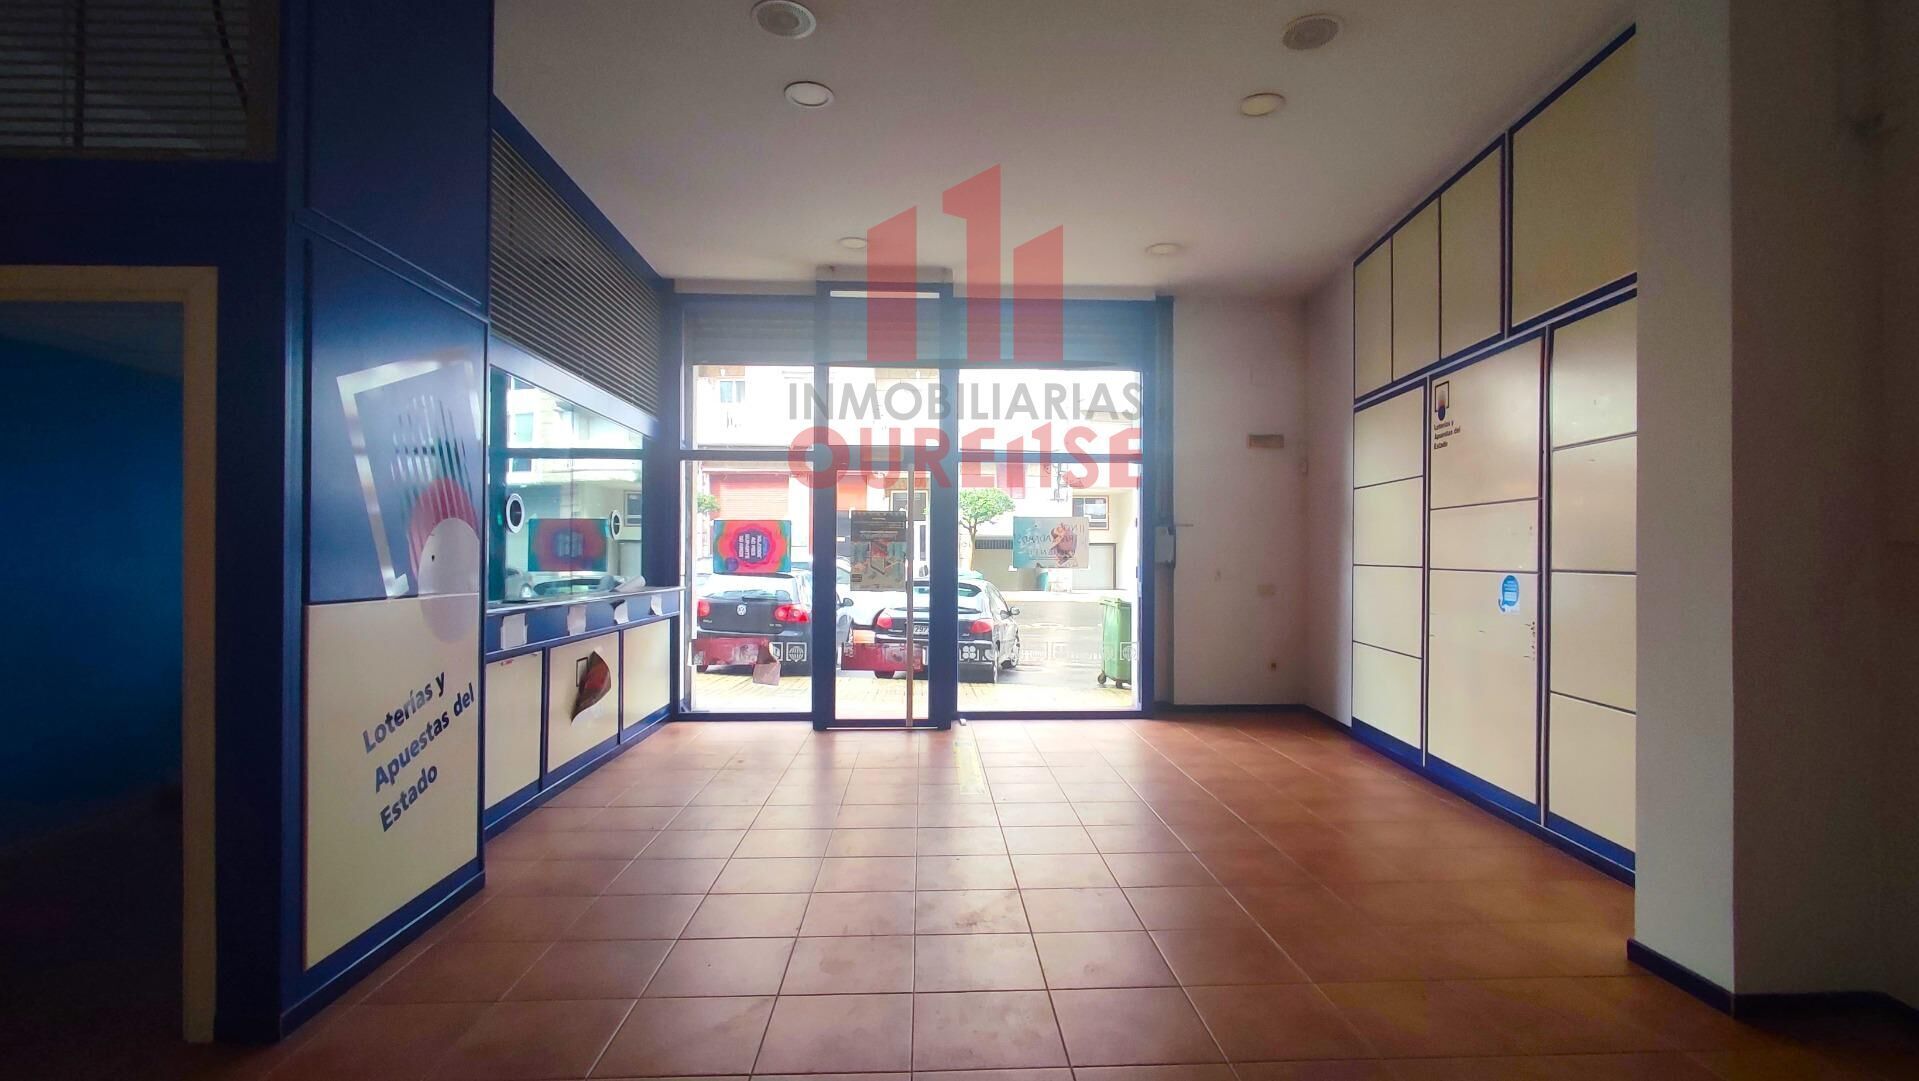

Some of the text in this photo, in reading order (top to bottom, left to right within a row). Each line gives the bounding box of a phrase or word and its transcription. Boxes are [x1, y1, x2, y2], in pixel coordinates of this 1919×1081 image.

[362, 671, 445, 754] Loterías y
[375, 682, 475, 793] Apuestas del
[380, 765, 438, 832] Estado
